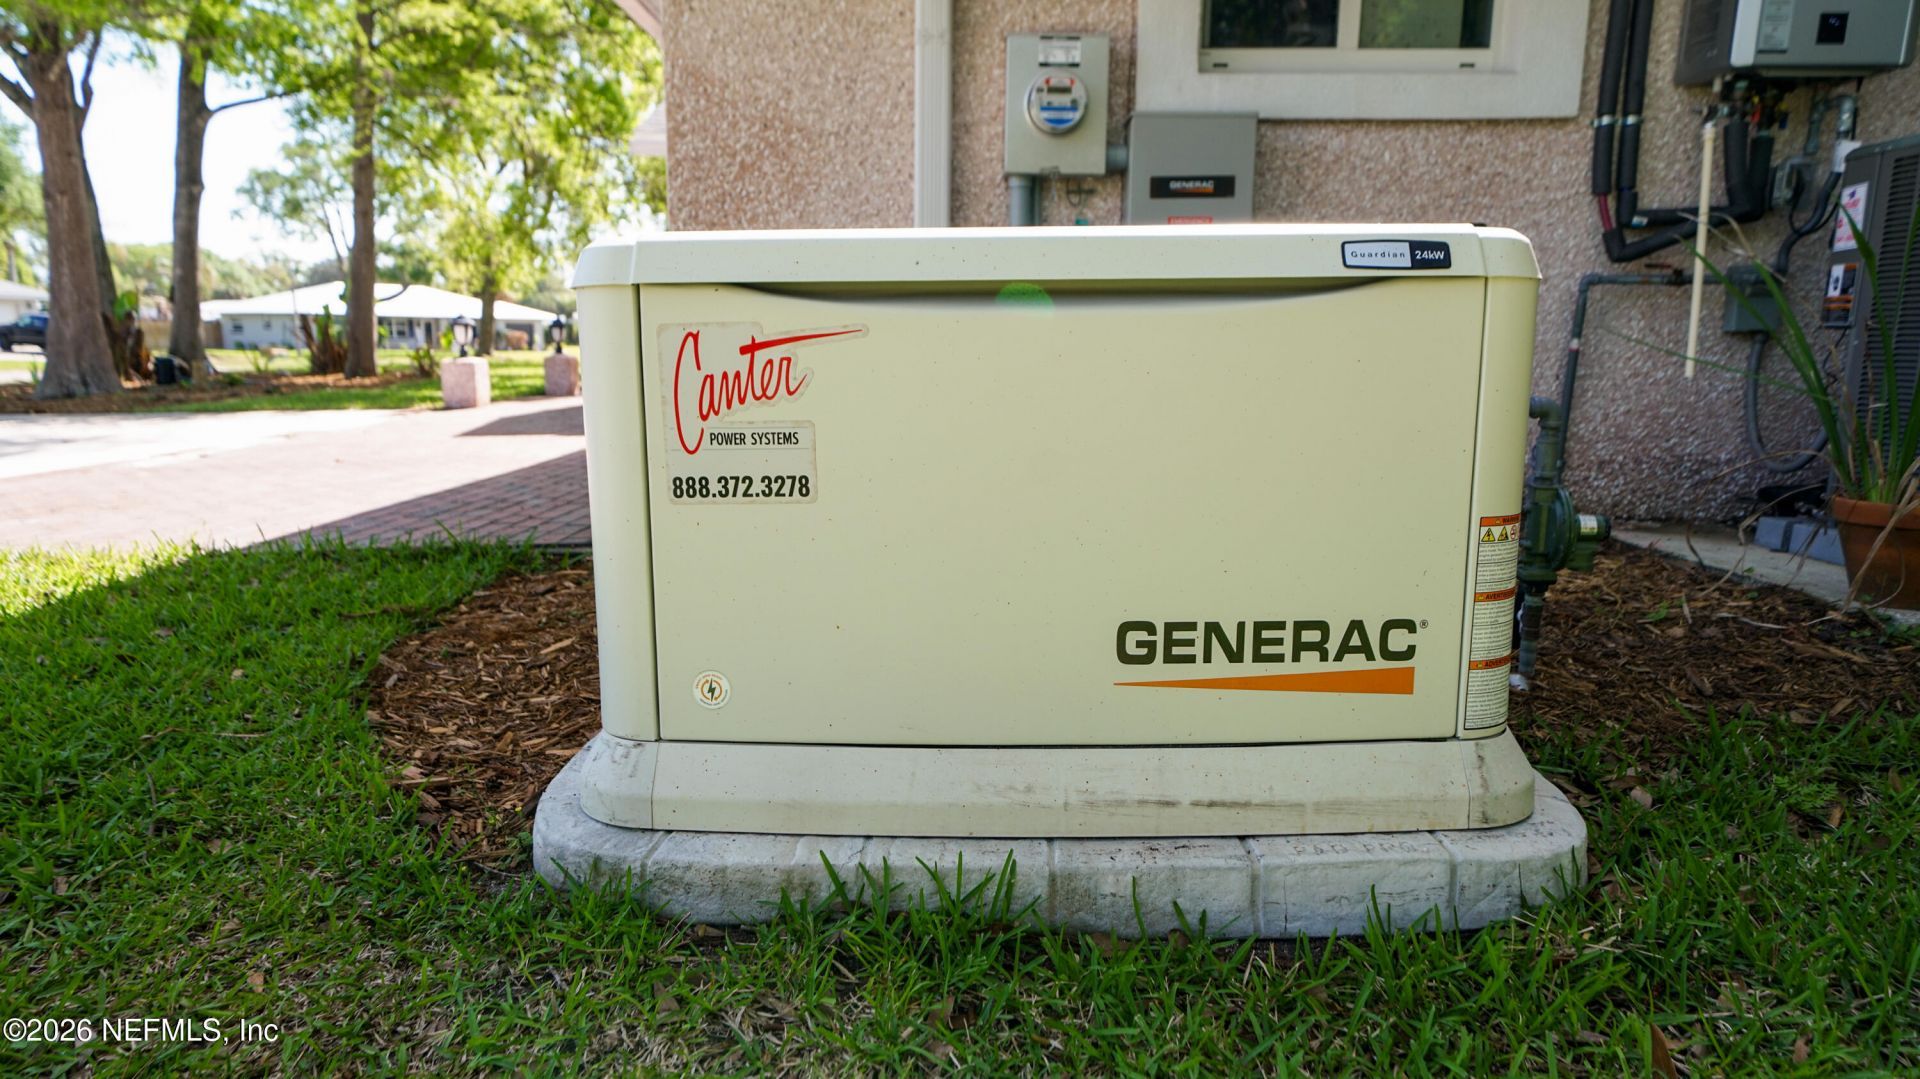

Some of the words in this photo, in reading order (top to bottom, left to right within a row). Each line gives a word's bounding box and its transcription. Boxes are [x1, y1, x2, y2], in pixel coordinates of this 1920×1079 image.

[1168, 180, 1215, 190] GENERAC
[1350, 251, 1405, 259] Guardian
[1414, 250, 1445, 260] 24kW
[674, 329, 863, 455] Canter
[709, 432, 746, 446] POWER
[751, 431, 799, 445] SYSTEMS
[672, 475, 810, 498] 888.372.3278
